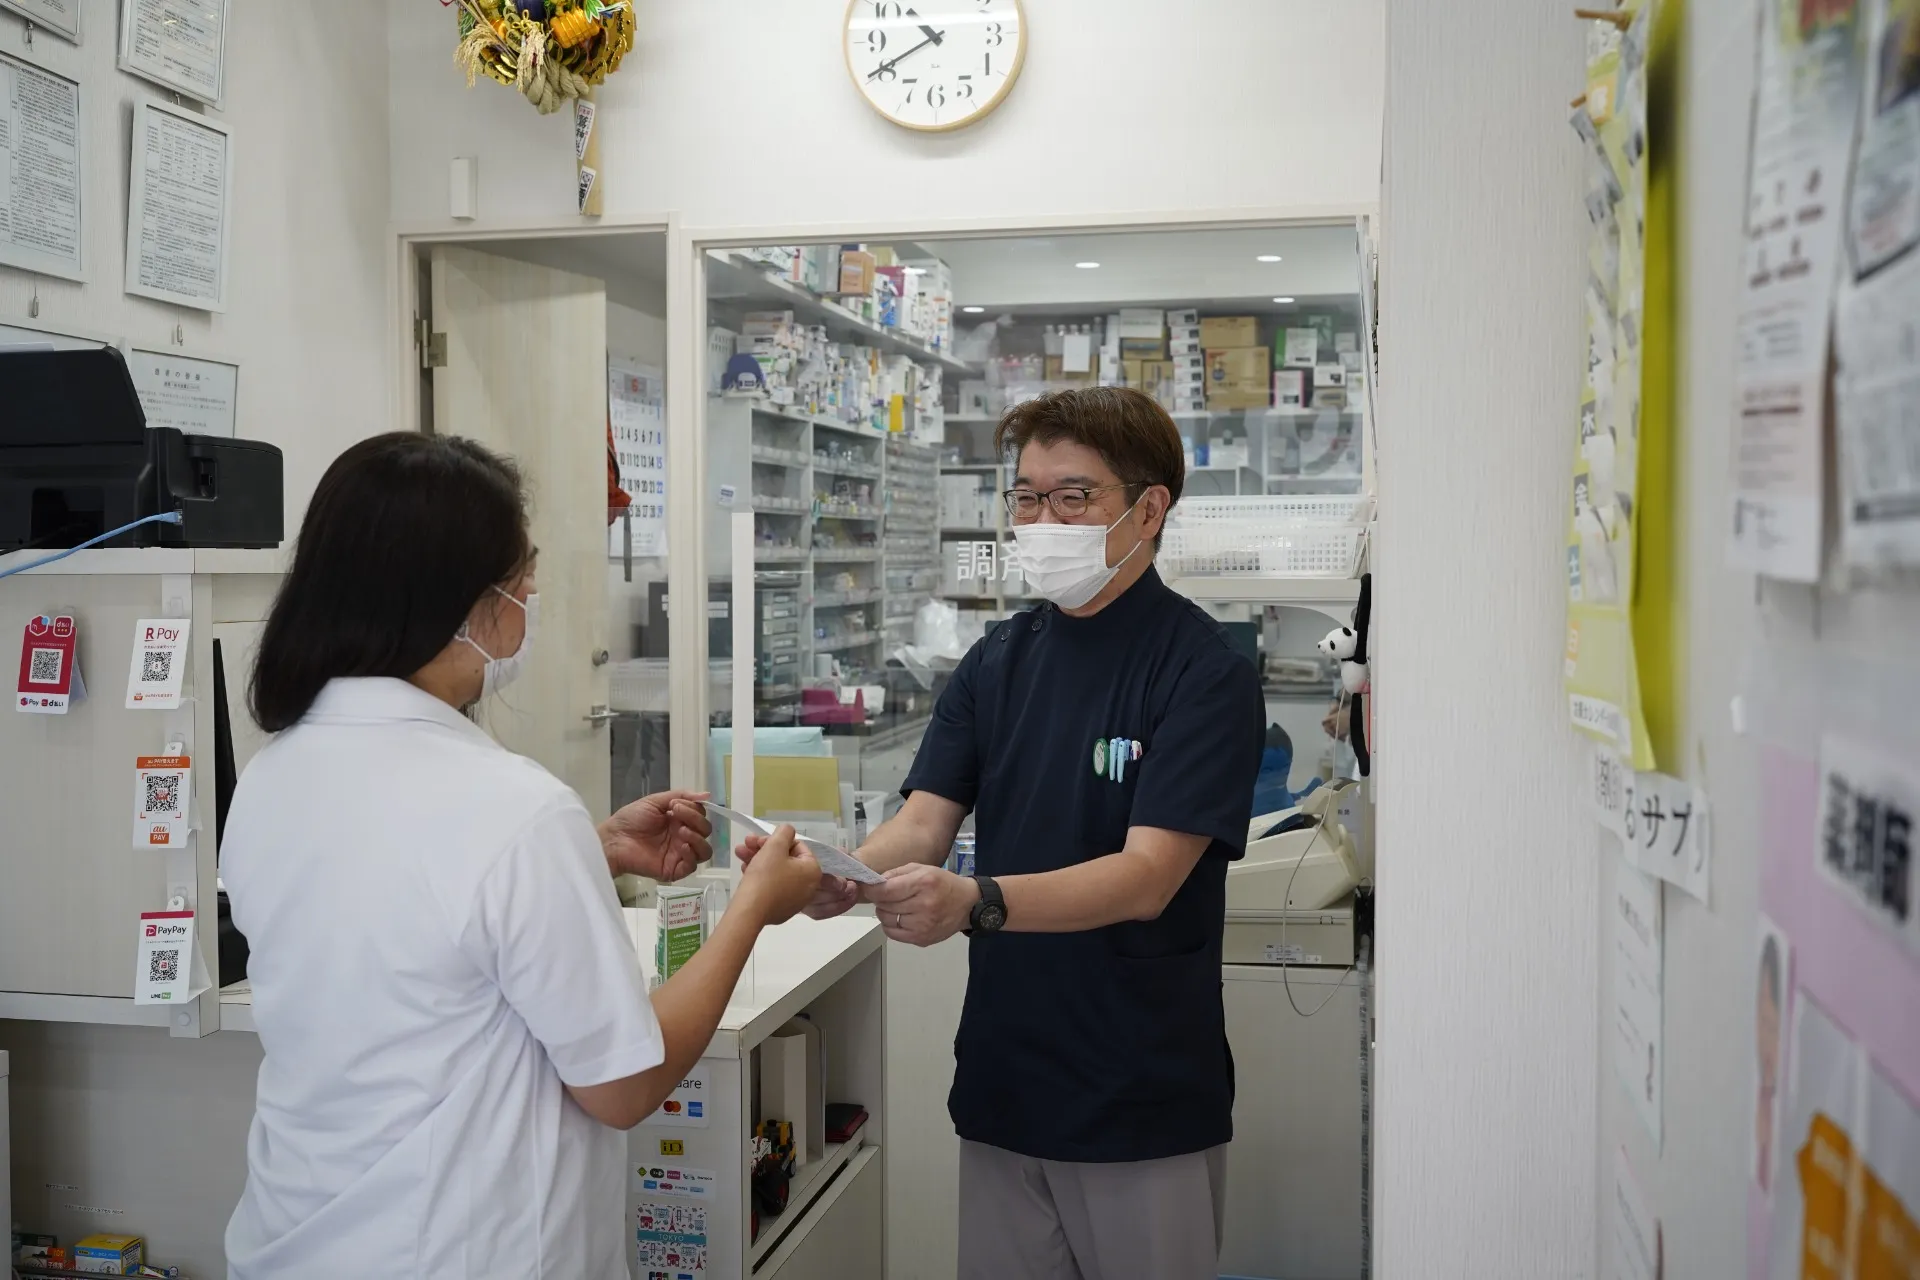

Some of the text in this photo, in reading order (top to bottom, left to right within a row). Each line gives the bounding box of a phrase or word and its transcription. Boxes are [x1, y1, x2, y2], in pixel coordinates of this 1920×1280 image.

[867, 29, 887, 53] 9
[986, 22, 1003, 48] 3
[877, 57, 897, 82] 8
[902, 78, 918, 104] 7
[926, 83, 945, 109] 6
[956, 74, 973, 98] 5
[634, 428, 638, 442] 5
[641, 429, 646, 443] 6
[157, 627, 180, 642] Pay
[152, 825, 168, 833] au
[157, 925, 187, 935] PayPay
[658, 1233, 684, 1241] TOKYO
